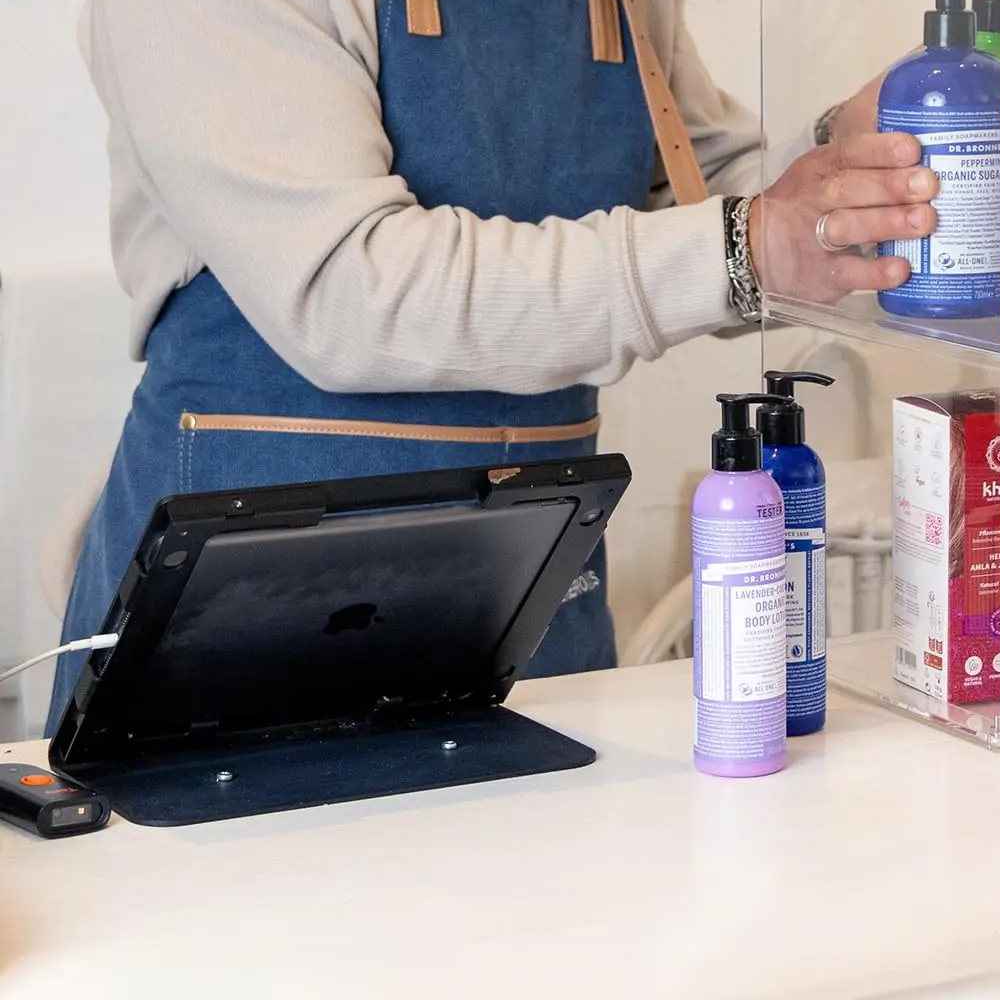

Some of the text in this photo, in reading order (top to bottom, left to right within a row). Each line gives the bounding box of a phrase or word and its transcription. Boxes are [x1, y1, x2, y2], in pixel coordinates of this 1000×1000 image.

[757, 506, 783, 518] TESTER
[970, 563, 989, 572] AMLA
[744, 576, 759, 584] DR.
[745, 615, 771, 628] BODY
